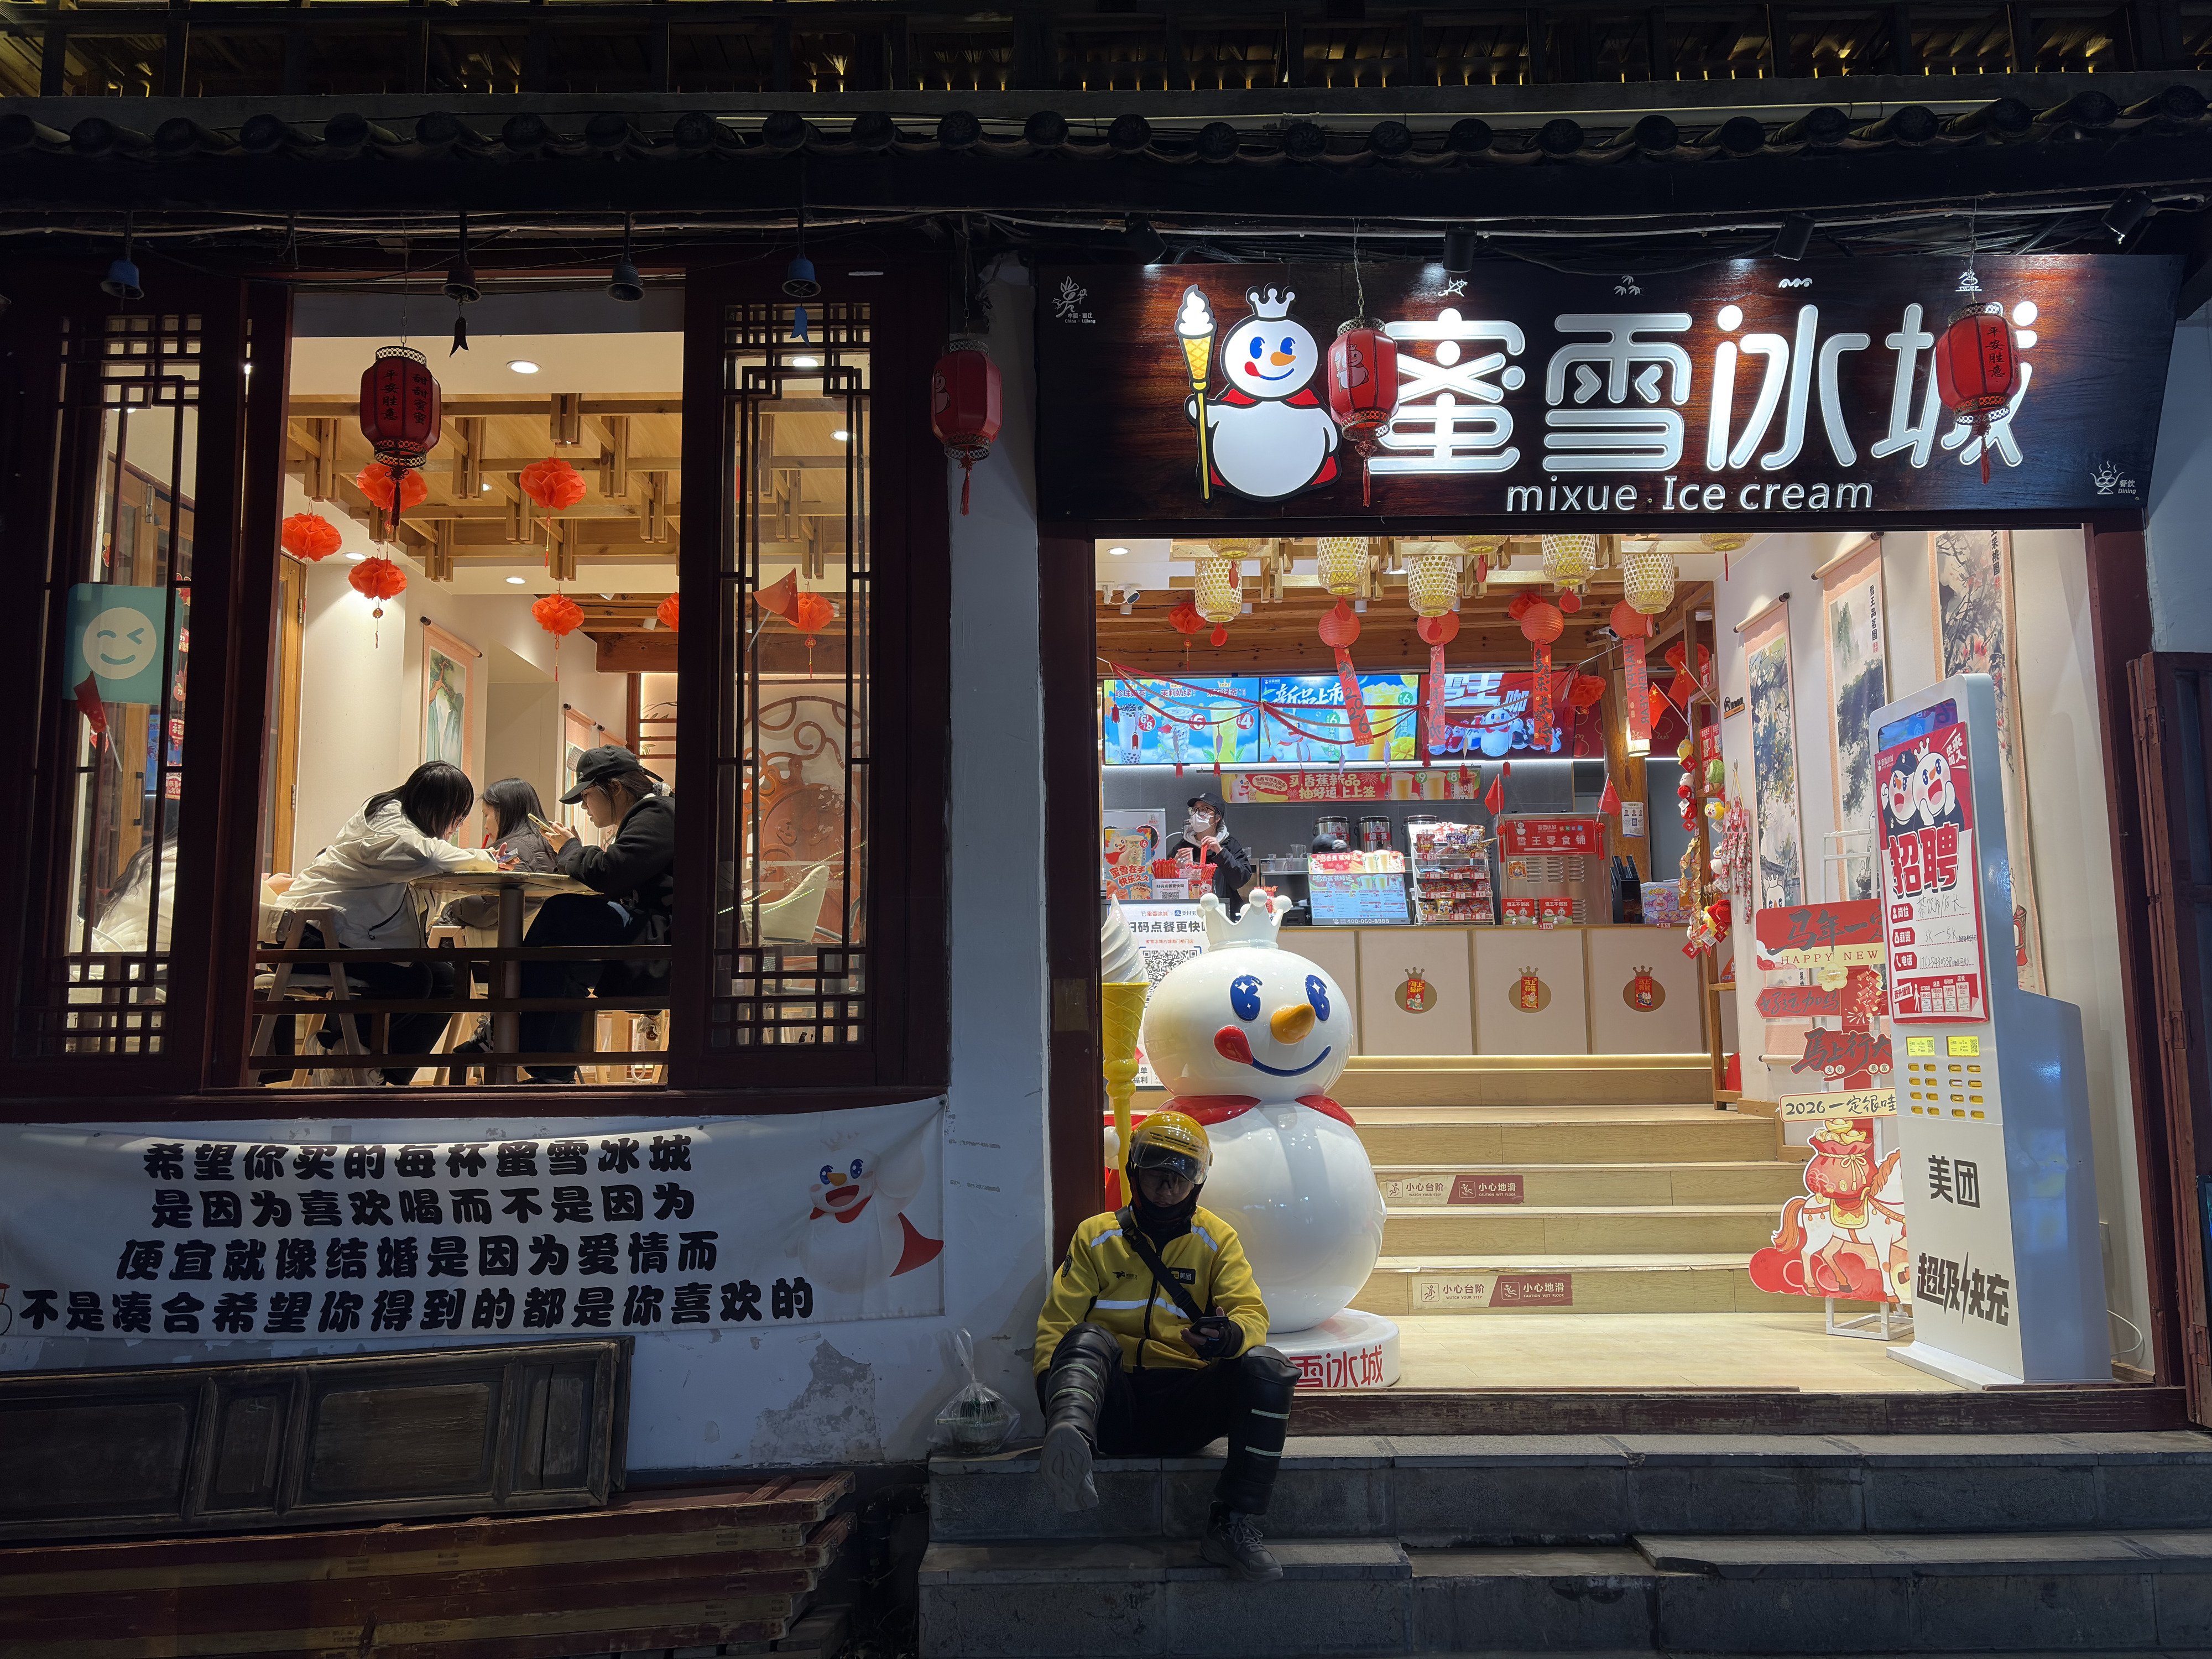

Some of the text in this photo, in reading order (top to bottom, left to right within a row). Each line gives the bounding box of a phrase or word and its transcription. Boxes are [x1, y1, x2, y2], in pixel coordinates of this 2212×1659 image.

[1985, 326, 2005, 378] 平安胜意
[1368, 302, 2039, 474] 蜜雪冰城
[380, 369, 400, 421] 平安胜意
[411, 373, 429, 425] 甜甜蜜蜜
[2119, 479, 2135, 488] 餐饮
[1506, 475, 1872, 511] mixue Ice cream
[1161, 689, 1191, 697] 茉莉奶绿
[1272, 682, 1346, 705] 新品上市
[1402, 694, 1410, 705] 6
[1345, 687, 1370, 734] 2026
[1241, 714, 1252, 728] 4
[1948, 750, 1966, 765] 加入
[1419, 773, 1426, 782] 9
[1451, 773, 1458, 781] 8
[1517, 835, 1586, 846] 雪王零食铺
[1888, 822, 1960, 899] 招聘
[1109, 865, 1145, 878] 蜜雪在手
[1118, 875, 1150, 887] 快乐久久
[1898, 906, 1909, 917] 岗位
[1900, 931, 1911, 942] 薪资
[1781, 951, 1878, 964] HAPPY NEW
[1901, 955, 1912, 966] 电话
[144, 1134, 692, 1181] 希望你买的每杯蜜雪冰城
[1406, 1183, 1444, 1192] 小心台阶
[1479, 1182, 1516, 1192] 小心地滑
[1928, 1155, 1980, 1208] 美团
[152, 1183, 695, 1228] 是因为喜欢喝而不是因为
[117, 1230, 718, 1281] 便宜就像结婚是因为爱情而
[1443, 1284, 1485, 1294] 小心台阶
[1523, 1282, 1564, 1292] 小心地滑
[1917, 1252, 2010, 1327] 超级快充
[19, 1276, 813, 1334] 不是凑合希望你得到的都是你喜欢的
